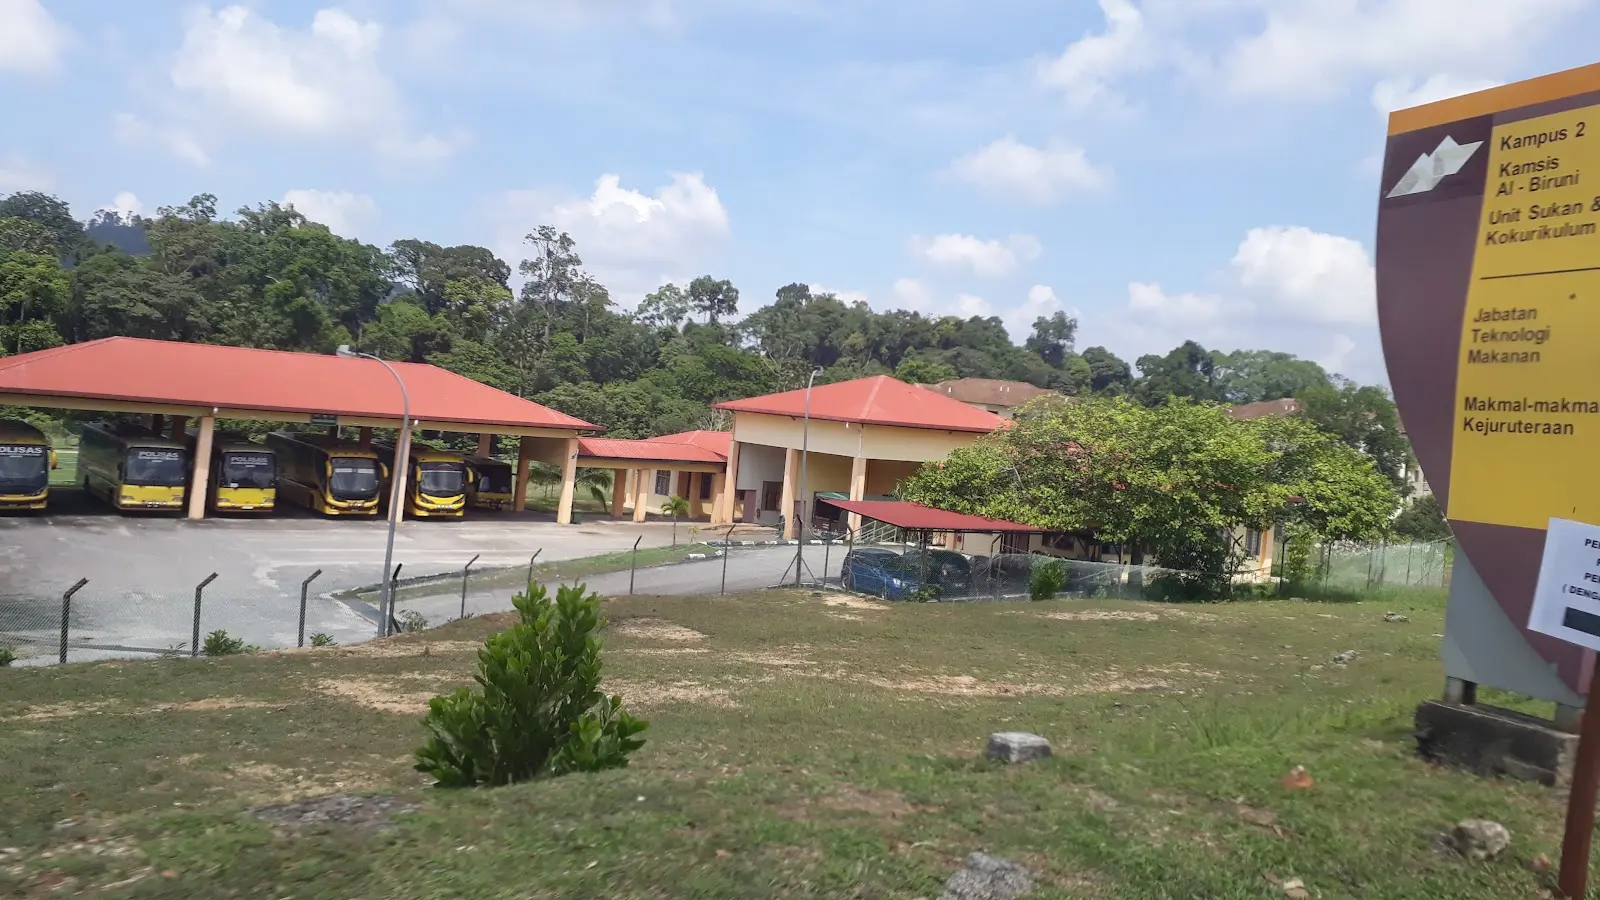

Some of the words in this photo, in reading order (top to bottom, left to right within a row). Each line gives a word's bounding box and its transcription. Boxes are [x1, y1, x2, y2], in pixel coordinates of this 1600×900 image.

[1500, 128, 1568, 151] Kampus
[1575, 121, 1586, 138] 2
[1499, 156, 1559, 178] Kamsis
[1496, 181, 1514, 197] Al
[1528, 170, 1580, 192] Biruni
[1488, 208, 1521, 226] Unit
[1528, 201, 1583, 221] Sukan
[1591, 195, 1600, 212] &
[1485, 221, 1596, 246] Kokurikulum
[1473, 306, 1538, 323] Jabatan
[1471, 326, 1551, 345] Teknologi
[1467, 349, 1541, 364] Makanan
[1464, 396, 1600, 413] Makmal-makma
[1463, 417, 1574, 436] Kejuruteraan
[1569, 585, 1600, 600] DENG
